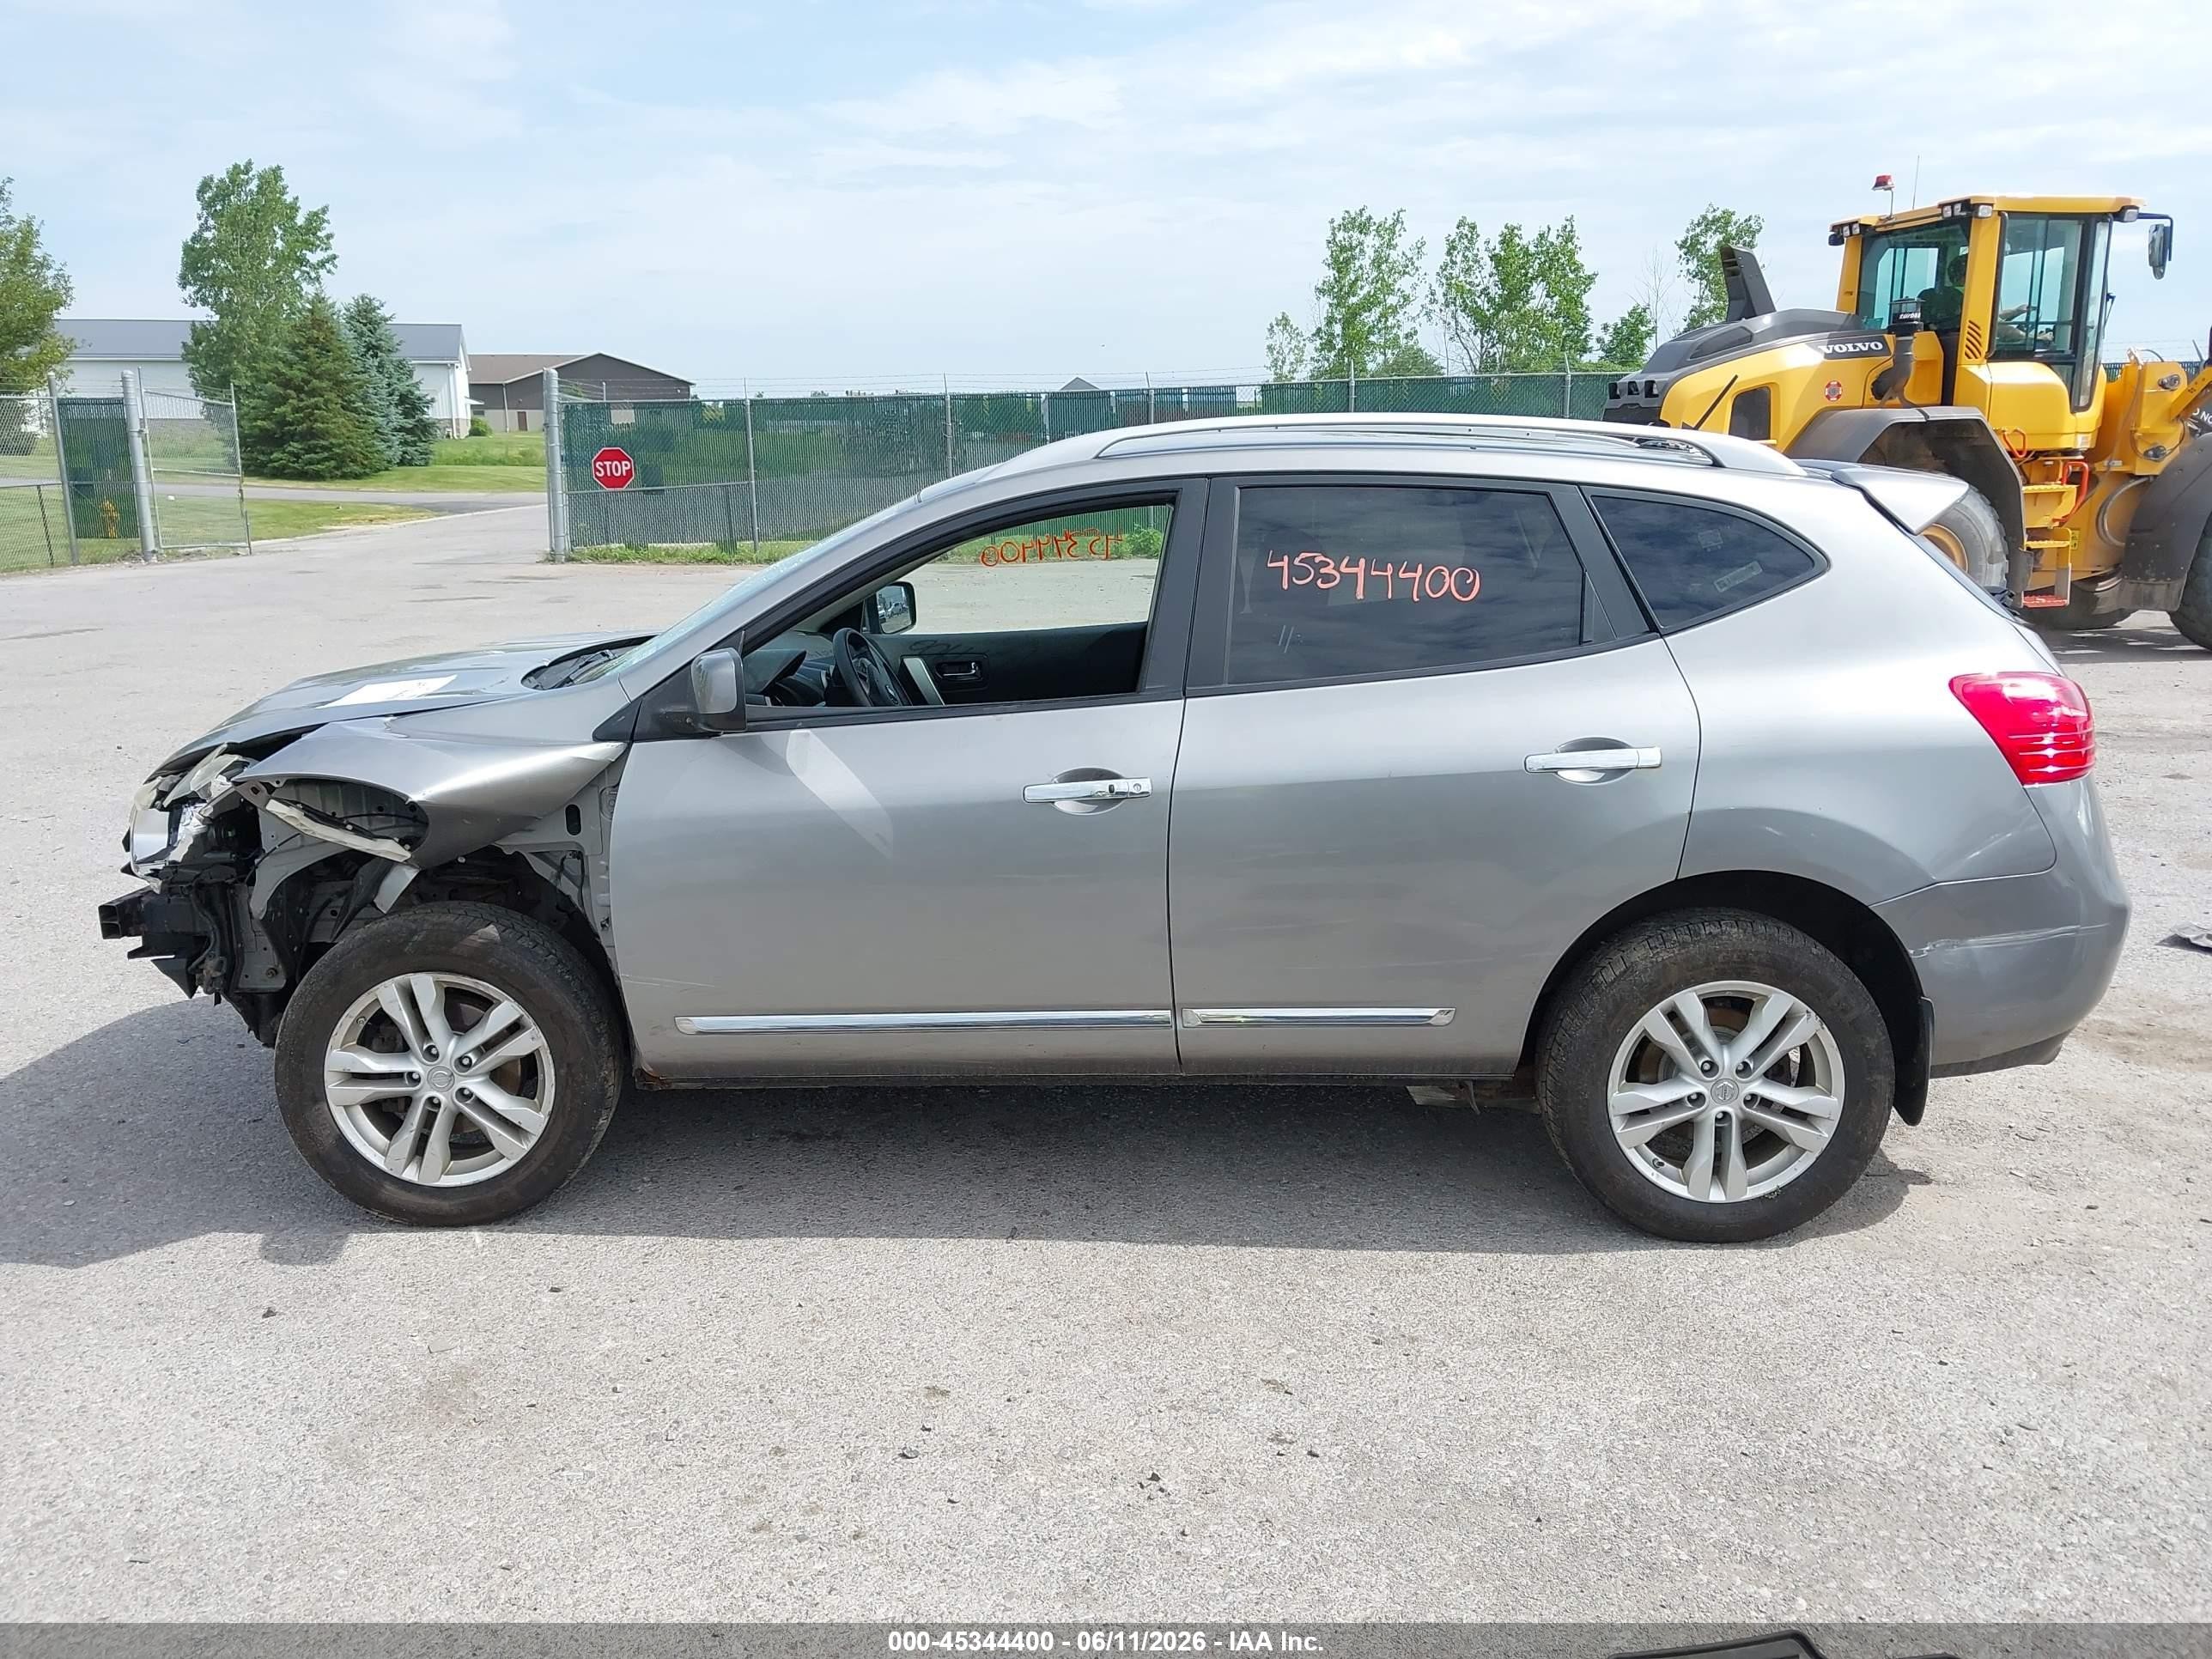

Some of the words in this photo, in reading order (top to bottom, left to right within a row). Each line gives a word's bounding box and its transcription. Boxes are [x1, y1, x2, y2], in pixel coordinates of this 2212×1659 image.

[1818, 341, 1883, 354] VOLVO
[595, 461, 631, 477] STOP
[1267, 550, 1480, 601] 45344400
